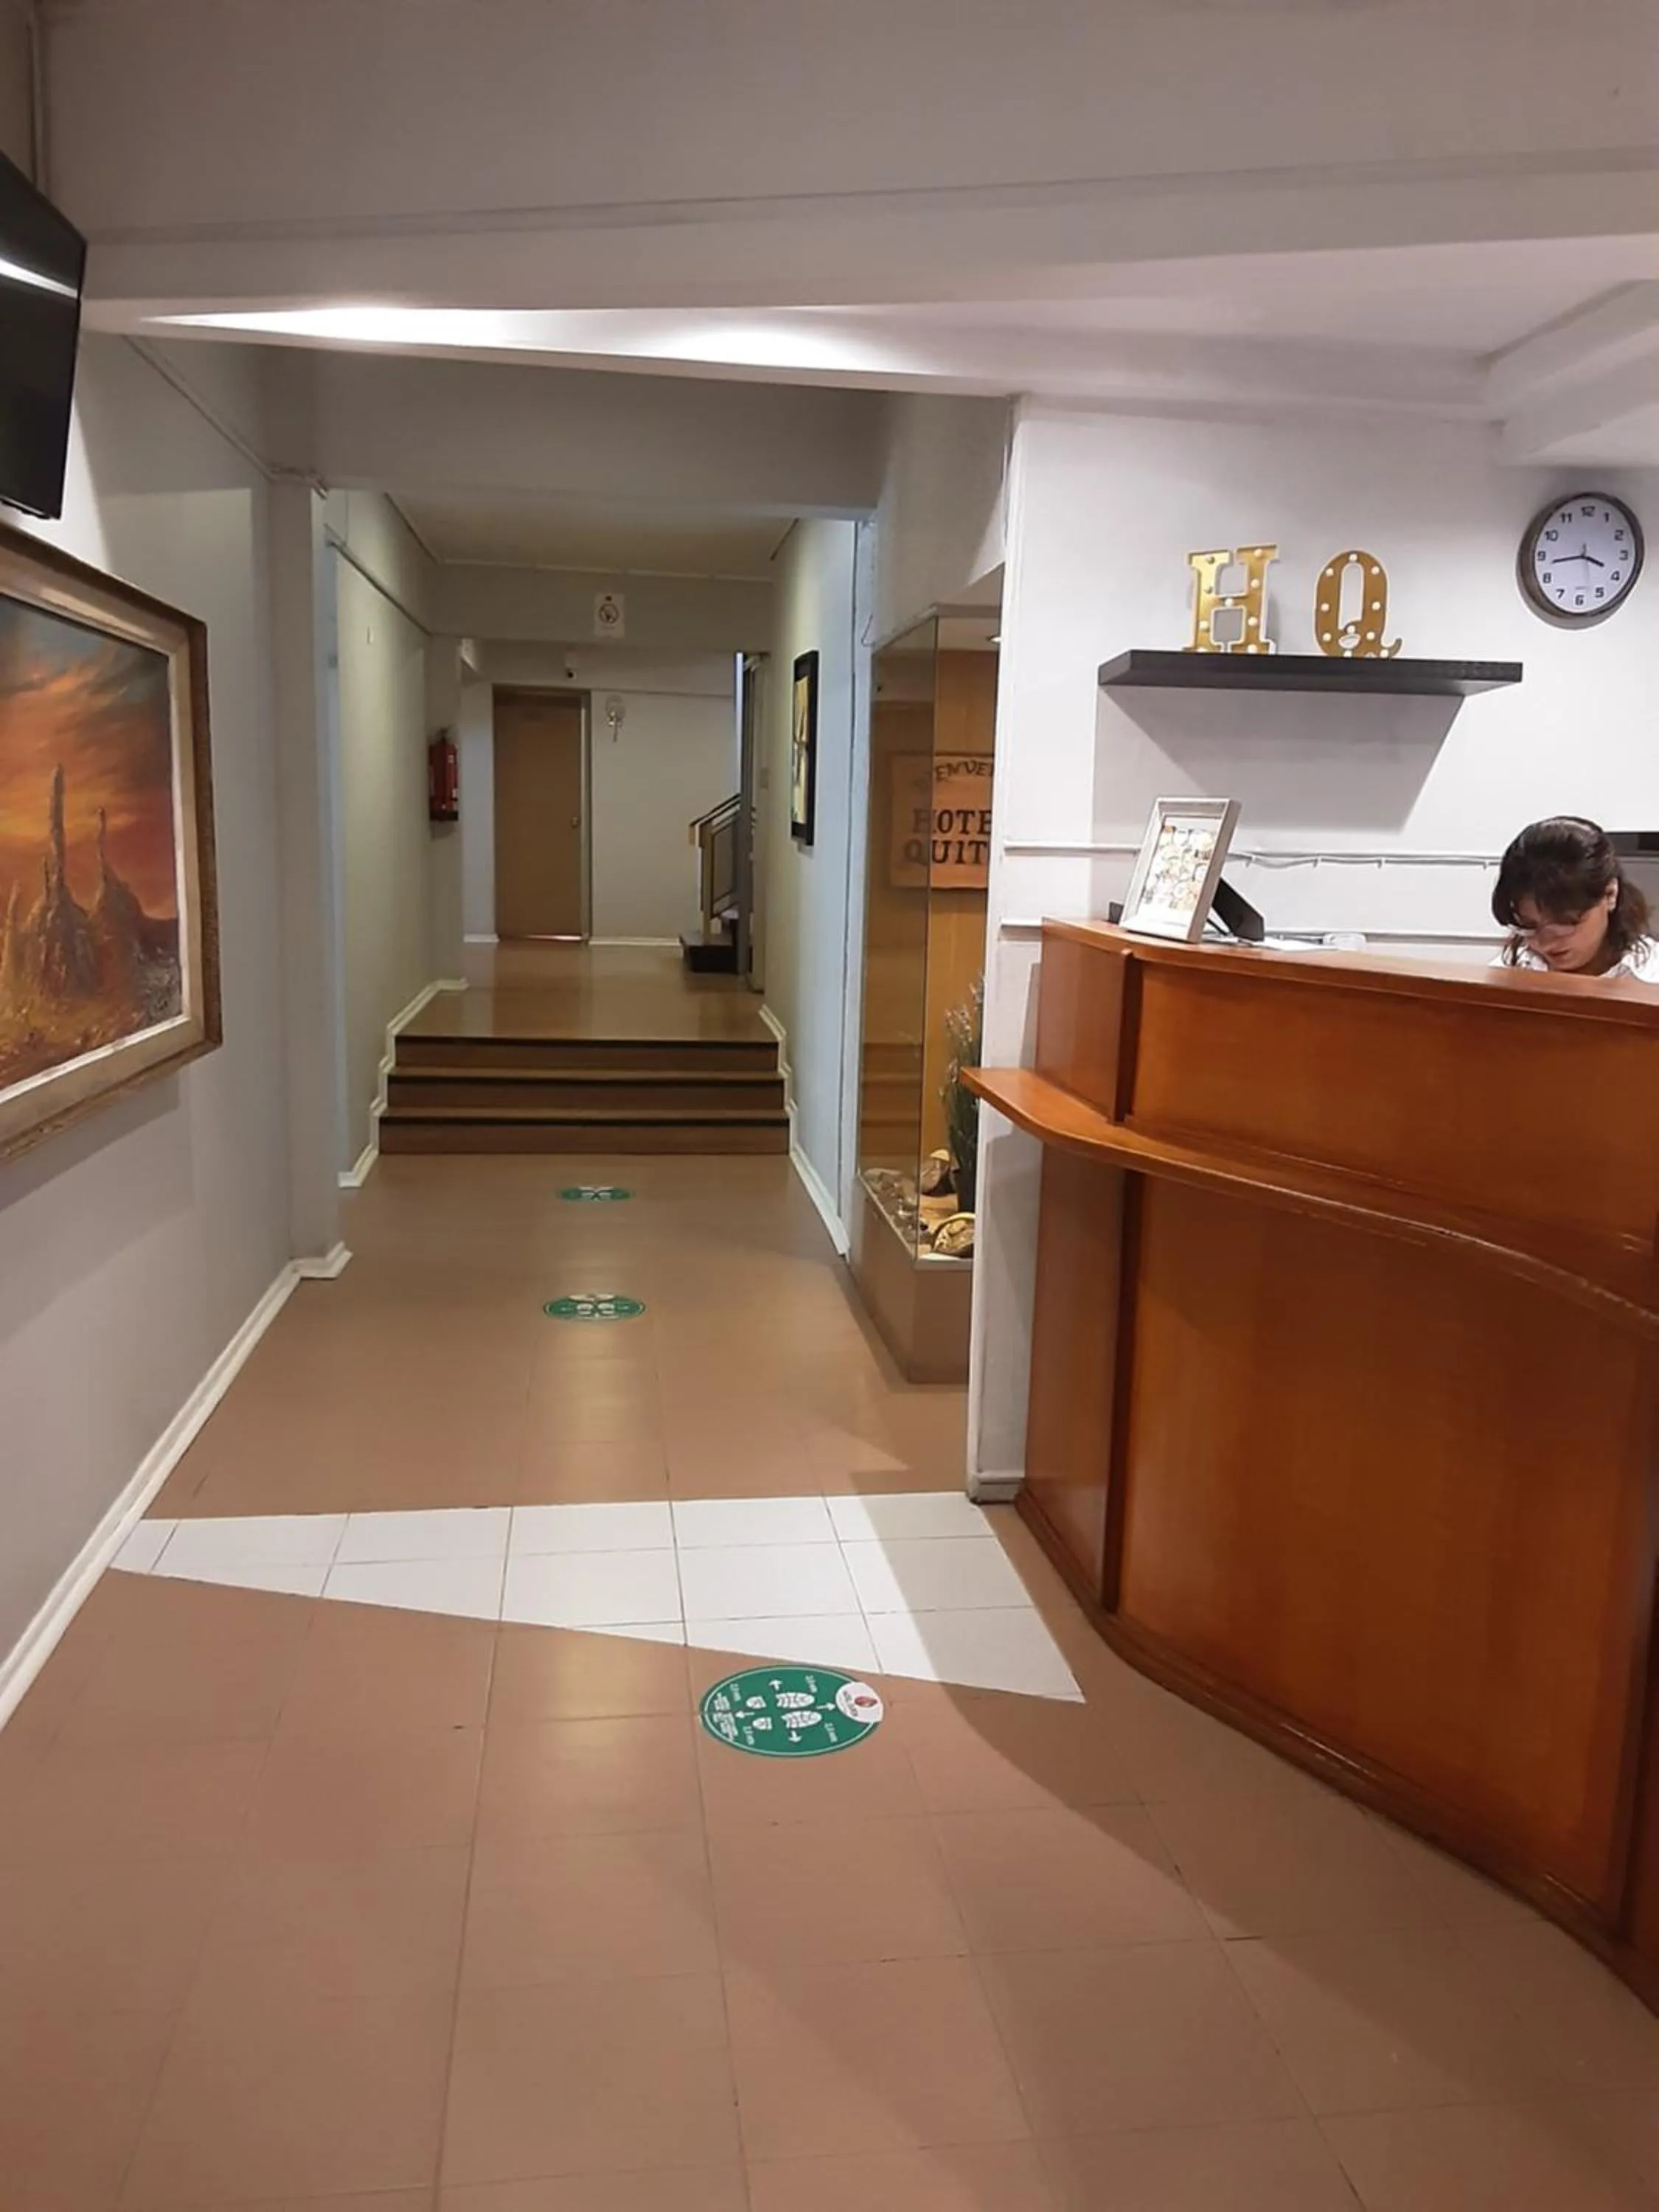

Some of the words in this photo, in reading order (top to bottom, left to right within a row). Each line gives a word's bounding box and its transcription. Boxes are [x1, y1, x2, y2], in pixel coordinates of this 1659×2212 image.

[1581, 505, 1596, 517] 12
[1560, 512, 1573, 524] 11
[1604, 512, 1610, 523] 1
[1545, 529, 1559, 541] 10
[1614, 529, 1624, 541] 2
[1537, 551, 1545, 561] 9
[1619, 550, 1628, 560] 3
[1543, 573, 1551, 583] 8
[1610, 571, 1620, 581] 4
[1557, 588, 1565, 599] 7
[1595, 587, 1604, 598] 5
[1575, 594, 1584, 605] 6
